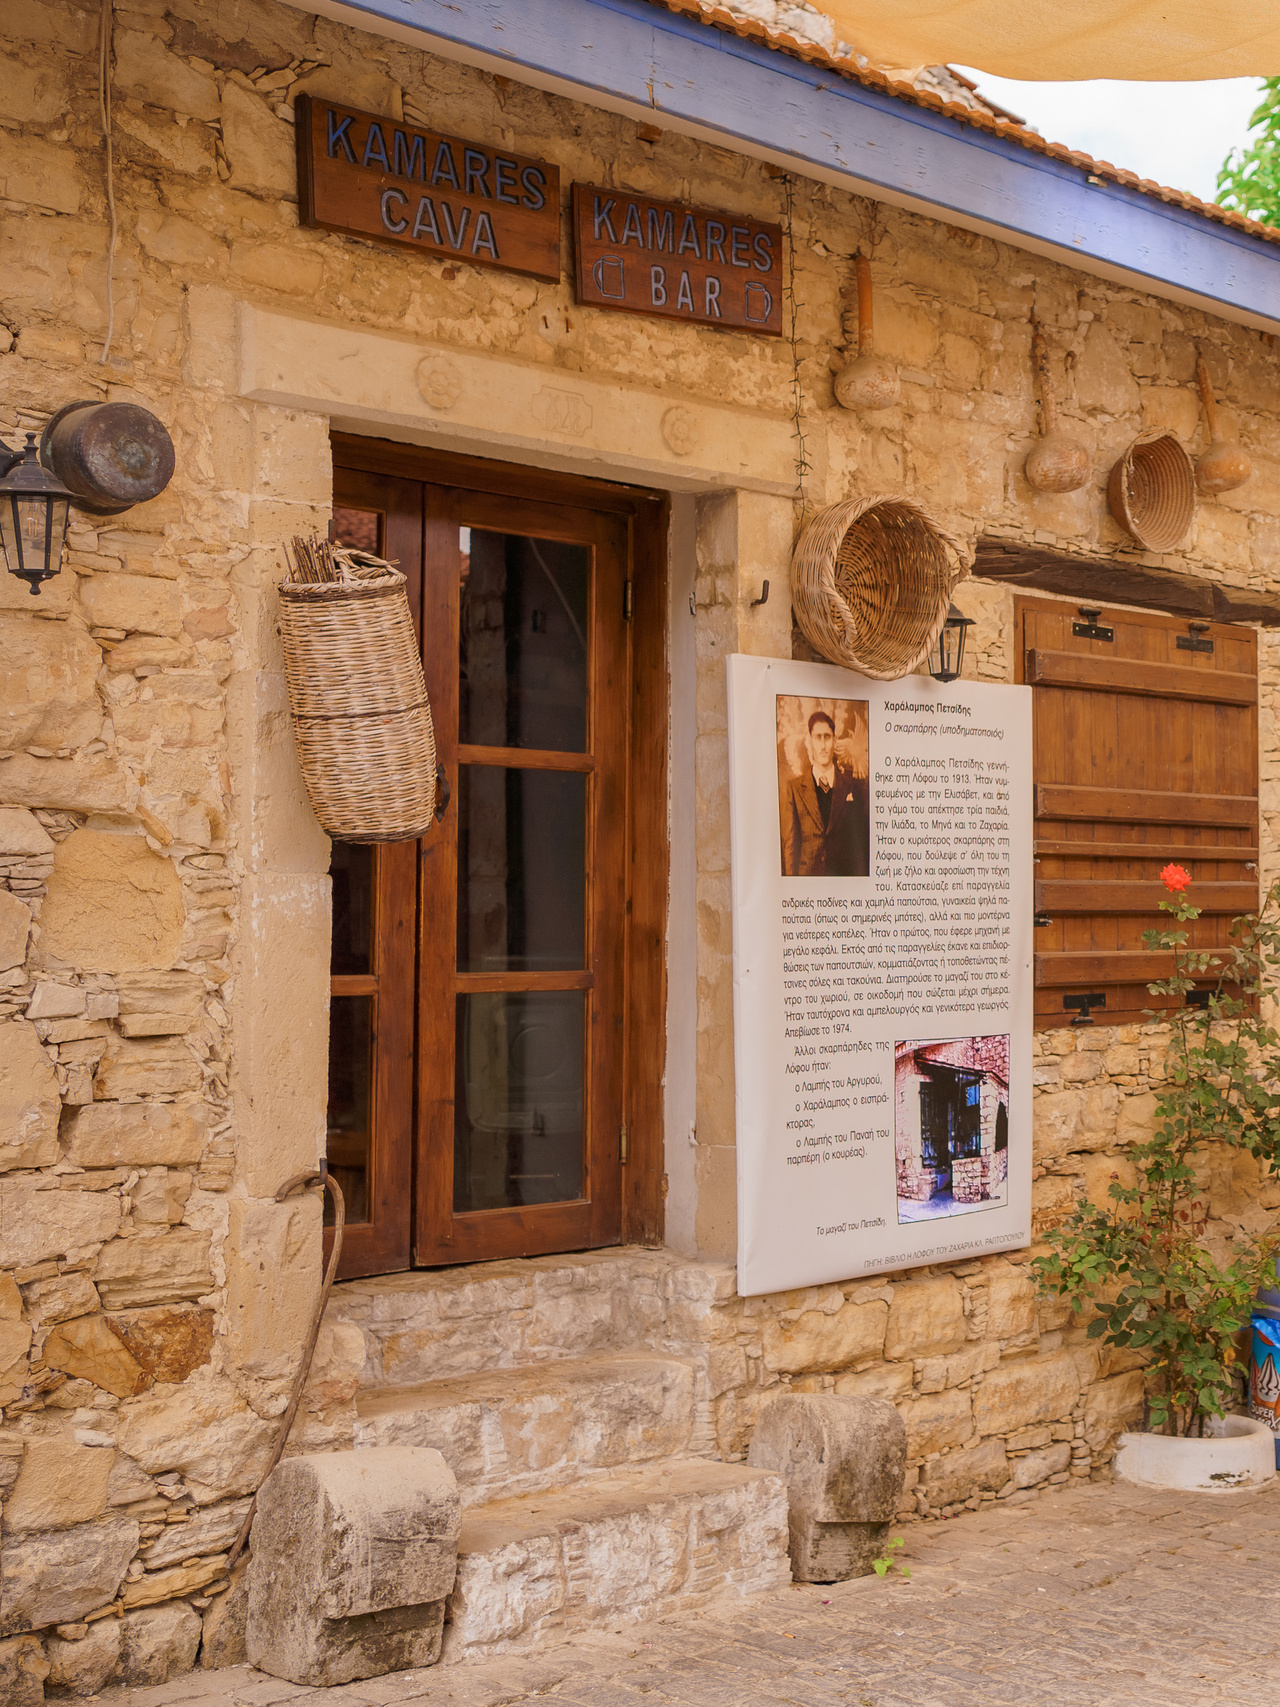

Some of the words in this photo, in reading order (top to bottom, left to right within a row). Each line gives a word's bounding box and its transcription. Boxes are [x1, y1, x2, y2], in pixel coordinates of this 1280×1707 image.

[325, 108, 548, 212] KAMARES
[379, 187, 501, 260] CAVA
[592, 196, 774, 273] KAMARES
[650, 264, 722, 318] BAR
[884, 701, 934, 714] Χαράλαμπος
[937, 703, 971, 717] Πετσίδης
[885, 722, 892, 730] Ο
[893, 723, 938, 736] σκαρπάρης
[940, 725, 1004, 740] (υποδηματοποιός)
[885, 756, 891, 766] Ο
[895, 757, 945, 770] Χαράλαμπος
[949, 758, 984, 771] Πετσίδης
[875, 772, 893, 784] θηκε
[896, 775, 910, 785] στη
[912, 772, 938, 785] Λόφου
[875, 788, 913, 800] φευμένος
[916, 791, 925, 800] με
[928, 791, 941, 800] την
[996, 791, 1010, 800] από
[875, 806, 885, 814] το
[887, 803, 908, 816] γάμο
[910, 806, 924, 814] του
[928, 804, 964, 816] απέκτησε
[967, 805, 982, 816] τρία
[875, 822, 889, 831] την
[932, 819, 952, 831] Μηνά
[900, 837, 905, 845] ο
[908, 835, 951, 847] κυριότερος
[953, 835, 995, 847] σκαρπάρης
[997, 838, 1009, 847] στη
[925, 850, 957, 862] δούλεψε
[971, 850, 984, 861] όλη
[987, 852, 999, 860] του
[1002, 853, 1009, 862] τη
[875, 865, 891, 877] ζωή
[893, 868, 902, 878] με
[904, 865, 922, 878] ζήλο
[938, 865, 975, 877] αφοσίωση
[977, 867, 989, 877] την
[991, 865, 1009, 877] τέχνη
[896, 881, 949, 892] Κατασκεύαζε
[952, 880, 964, 890] επί
[966, 880, 1010, 892] παραγγελία
[782, 897, 814, 910] ανδρικές
[817, 897, 848, 909] ποδίνες
[851, 899, 863, 907] και
[865, 896, 895, 909] χαμηλά
[941, 895, 976, 907] γυναικεία
[978, 895, 996, 907] ψηλά
[782, 913, 811, 924] πούτσια
[814, 913, 838, 925] (όπως
[841, 915, 848, 923] οι
[851, 912, 892, 925] σημερινές
[929, 911, 948, 921] αλλά
[978, 910, 1010, 922] μοντέρνα
[782, 932, 794, 942] για
[795, 929, 830, 941] νεότερες
[950, 926, 973, 938] έφερε
[975, 925, 1000, 937] μηχανή
[1002, 927, 1010, 936] με
[784, 996, 802, 1007] ντρο
[805, 995, 818, 1004] του
[854, 993, 864, 1001] σε
[867, 988, 904, 1001] οικοδομή
[907, 990, 922, 998] που
[926, 987, 956, 999] σώζεται
[959, 986, 978, 998] μέχρι
[806, 1008, 850, 1020] ταυτόχρονα
[853, 1008, 864, 1016] και
[866, 1003, 920, 1018] αμπελουργός
[922, 1005, 933, 1013] και
[935, 1002, 975, 1015] γενικότερα
[784, 1026, 820, 1038] Απεβίωσε
[821, 1026, 830, 1034] το
[819, 1041, 872, 1055] σκαρπάρηδες
[875, 1041, 890, 1051] της
[785, 1063, 810, 1075] Λόφου
[812, 1060, 831, 1073] ήταν:
[795, 1084, 800, 1092] ο
[801, 1079, 830, 1093] Λαμπής
[831, 1080, 845, 1088] του
[795, 1104, 800, 1112] ο
[803, 1098, 850, 1112] Χαράλαμπος
[853, 1097, 858, 1105] ο
[796, 1140, 801, 1148] ο
[803, 1134, 832, 1148] Λαμπής
[834, 1134, 847, 1143] του
[850, 1128, 874, 1141] Παναή
[876, 1130, 889, 1138] του
[787, 1152, 820, 1166] παρπέρη
[822, 1152, 830, 1161] (ο
[817, 1227, 824, 1235] Το
[825, 1222, 847, 1236] μαγαζί
[860, 1217, 886, 1228] Πετσίδη.
[1251, 1400, 1275, 1419] SUPER
